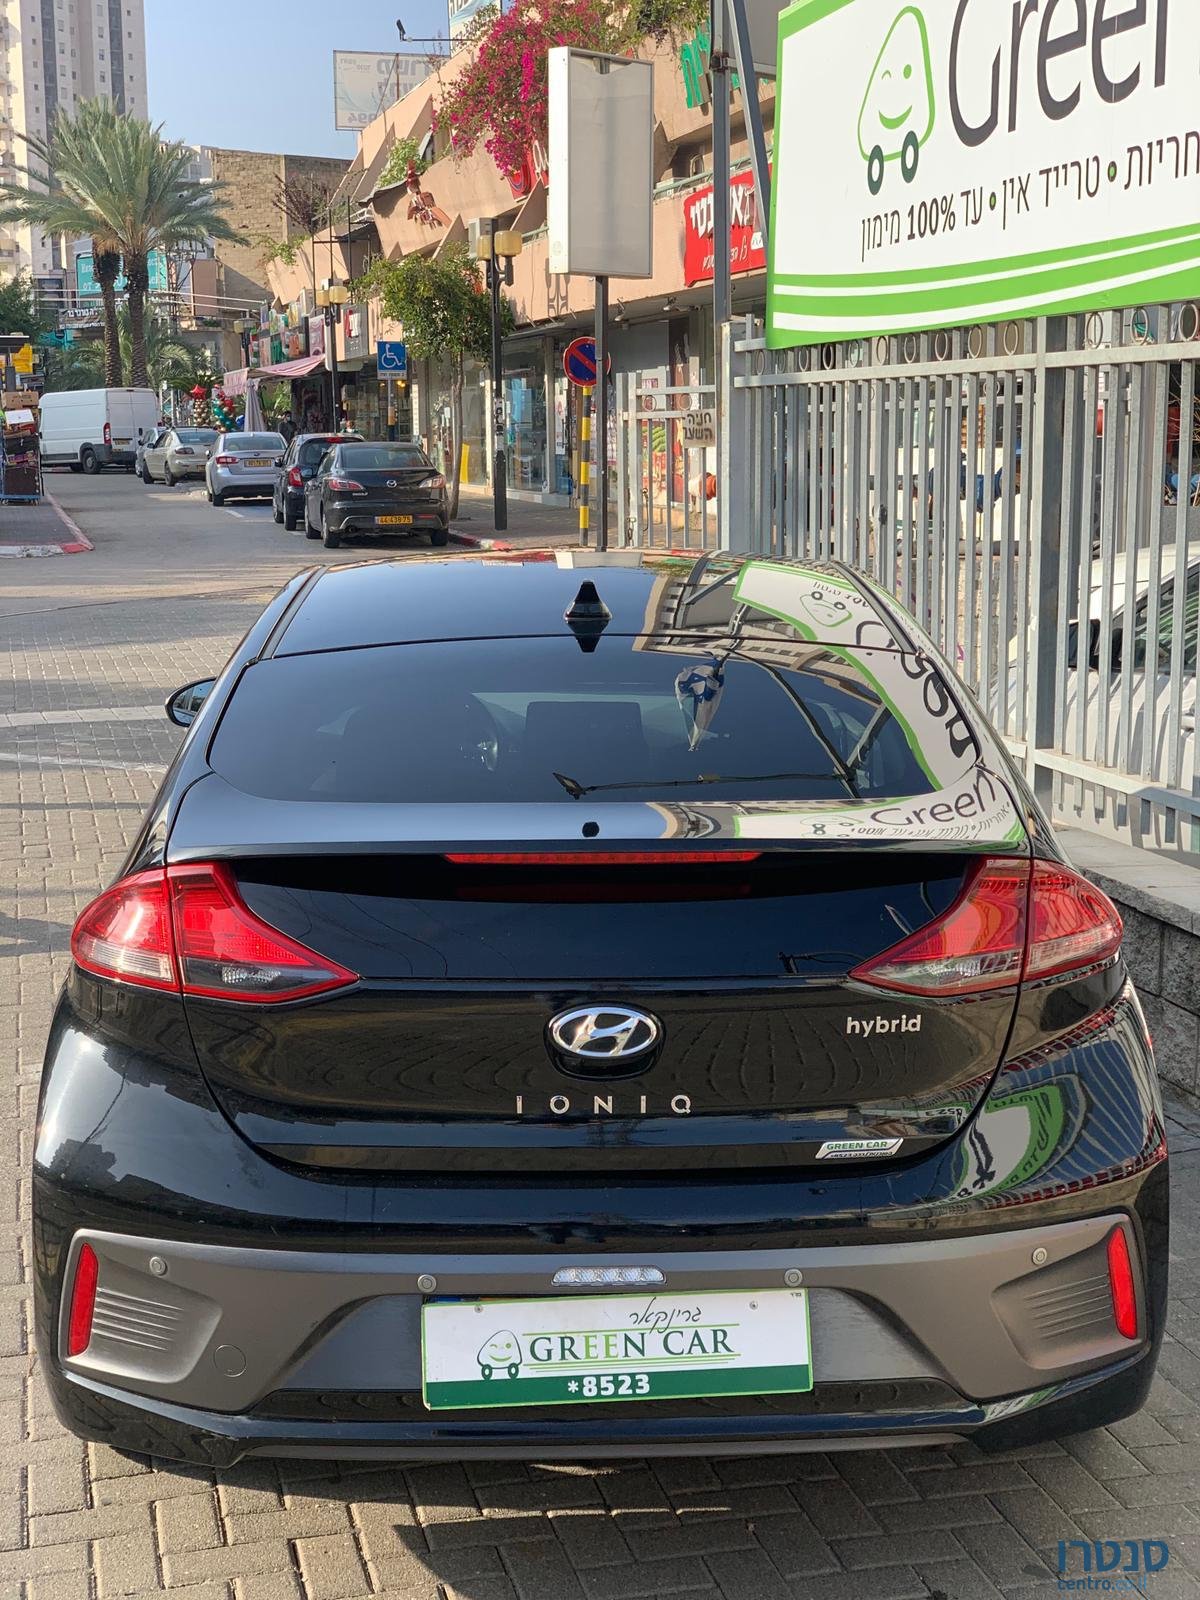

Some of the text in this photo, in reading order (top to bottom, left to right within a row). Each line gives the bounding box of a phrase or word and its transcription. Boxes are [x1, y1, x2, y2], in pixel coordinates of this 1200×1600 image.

[1002, 172, 1031, 230] אין
[1039, 155, 1099, 208] טרייד
[907, 194, 956, 241] 100%
[961, 186, 983, 226] עד
[861, 209, 901, 263] מימון
[846, 1015, 922, 1037] hybrid
[516, 1094, 692, 1115] IONIQ
[827, 1141, 888, 1151] GREEN CAR
[529, 1329, 734, 1361] GREEN CAR
